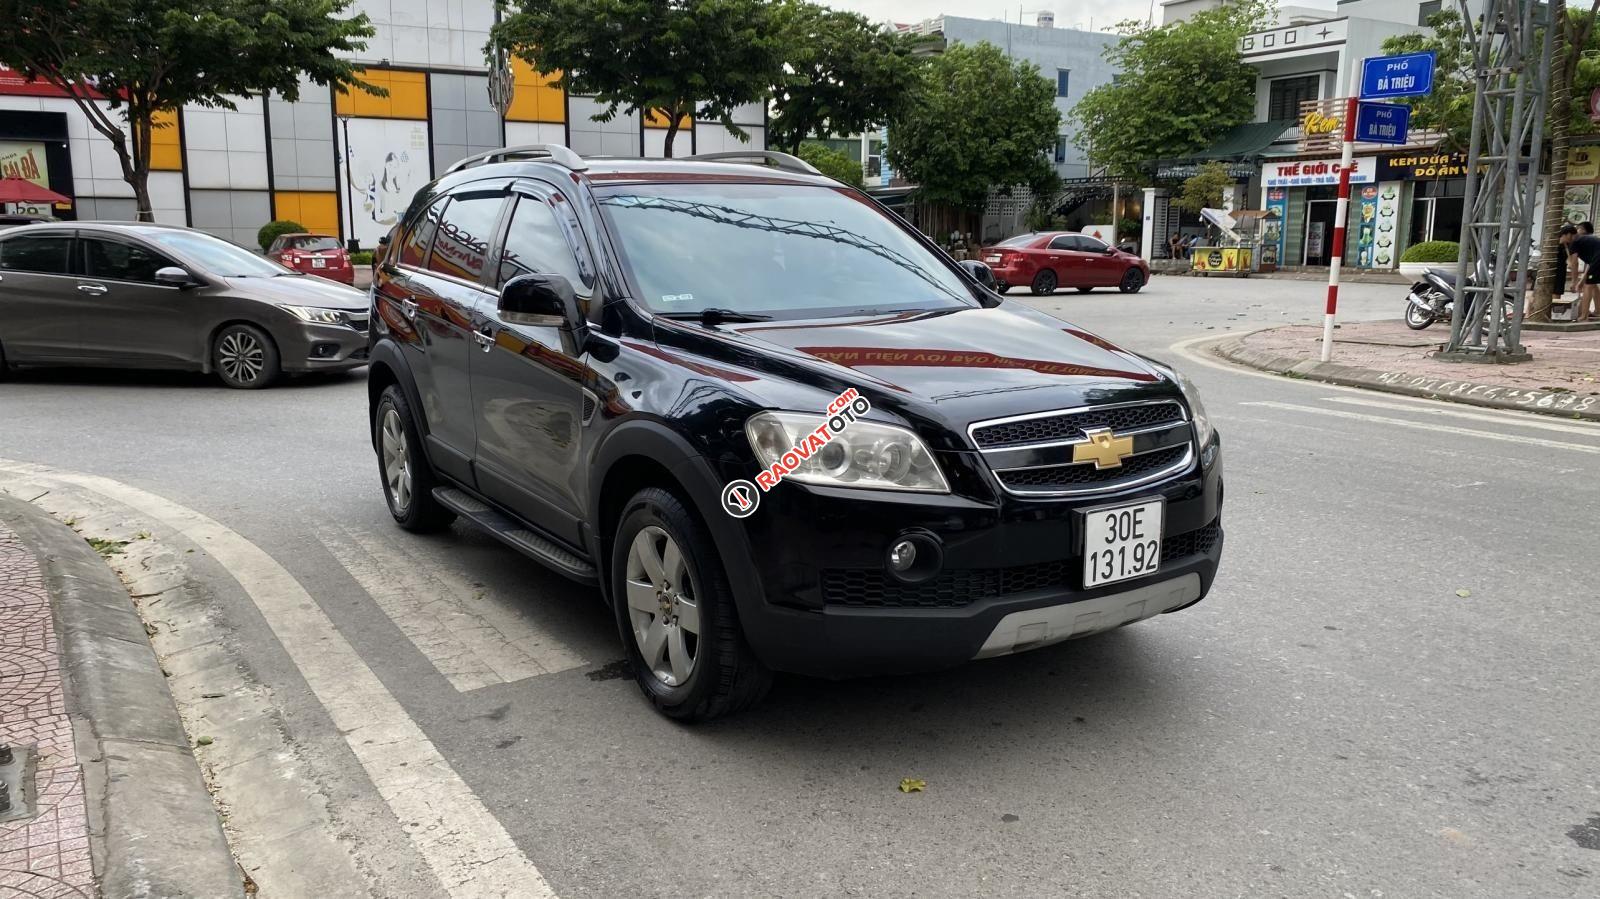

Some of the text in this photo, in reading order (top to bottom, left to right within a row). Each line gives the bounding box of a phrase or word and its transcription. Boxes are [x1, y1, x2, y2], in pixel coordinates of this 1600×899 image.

[1387, 60, 1409, 71] PHỐ
[1390, 73, 1416, 91] TRIỆU
[1376, 109, 1393, 119] PHỐ
[1378, 122, 1397, 139] TRIỆU
[1277, 160, 1359, 177] THẾ GIỚI CÈ
[1389, 157, 1417, 167] KEM
[1438, 164, 1459, 176] ĂN
[1104, 507, 1145, 544] 30E
[1090, 540, 1158, 582] 131.92
